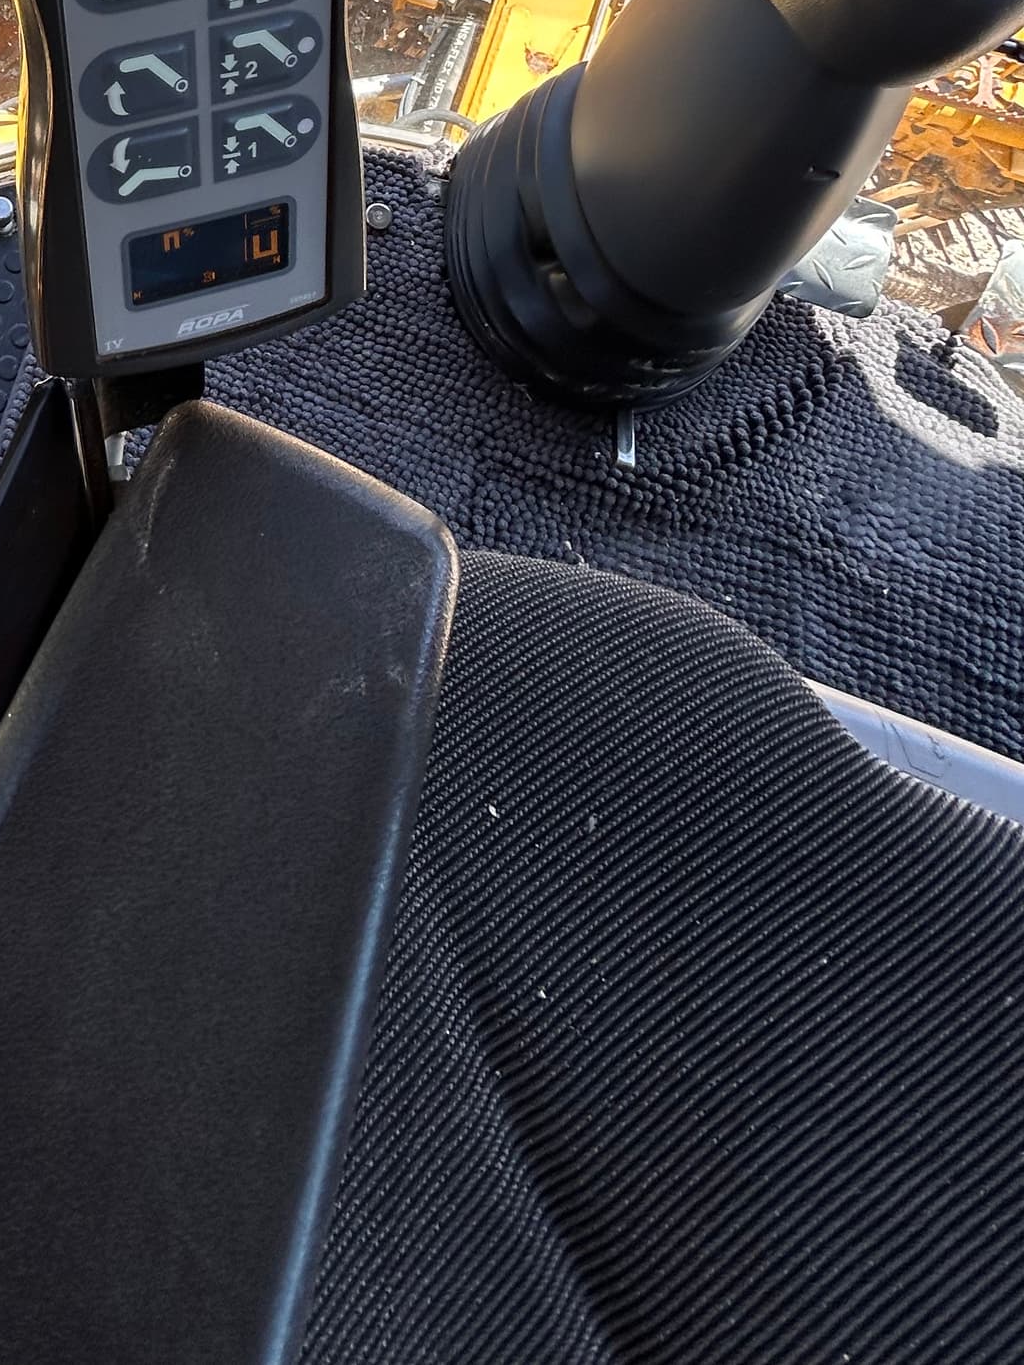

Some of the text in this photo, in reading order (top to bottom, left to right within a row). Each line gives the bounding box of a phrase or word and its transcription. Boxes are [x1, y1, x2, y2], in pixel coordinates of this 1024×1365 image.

[244, 60, 259, 80] 2
[247, 141, 258, 158] 1
[177, 304, 251, 335] ROPA
